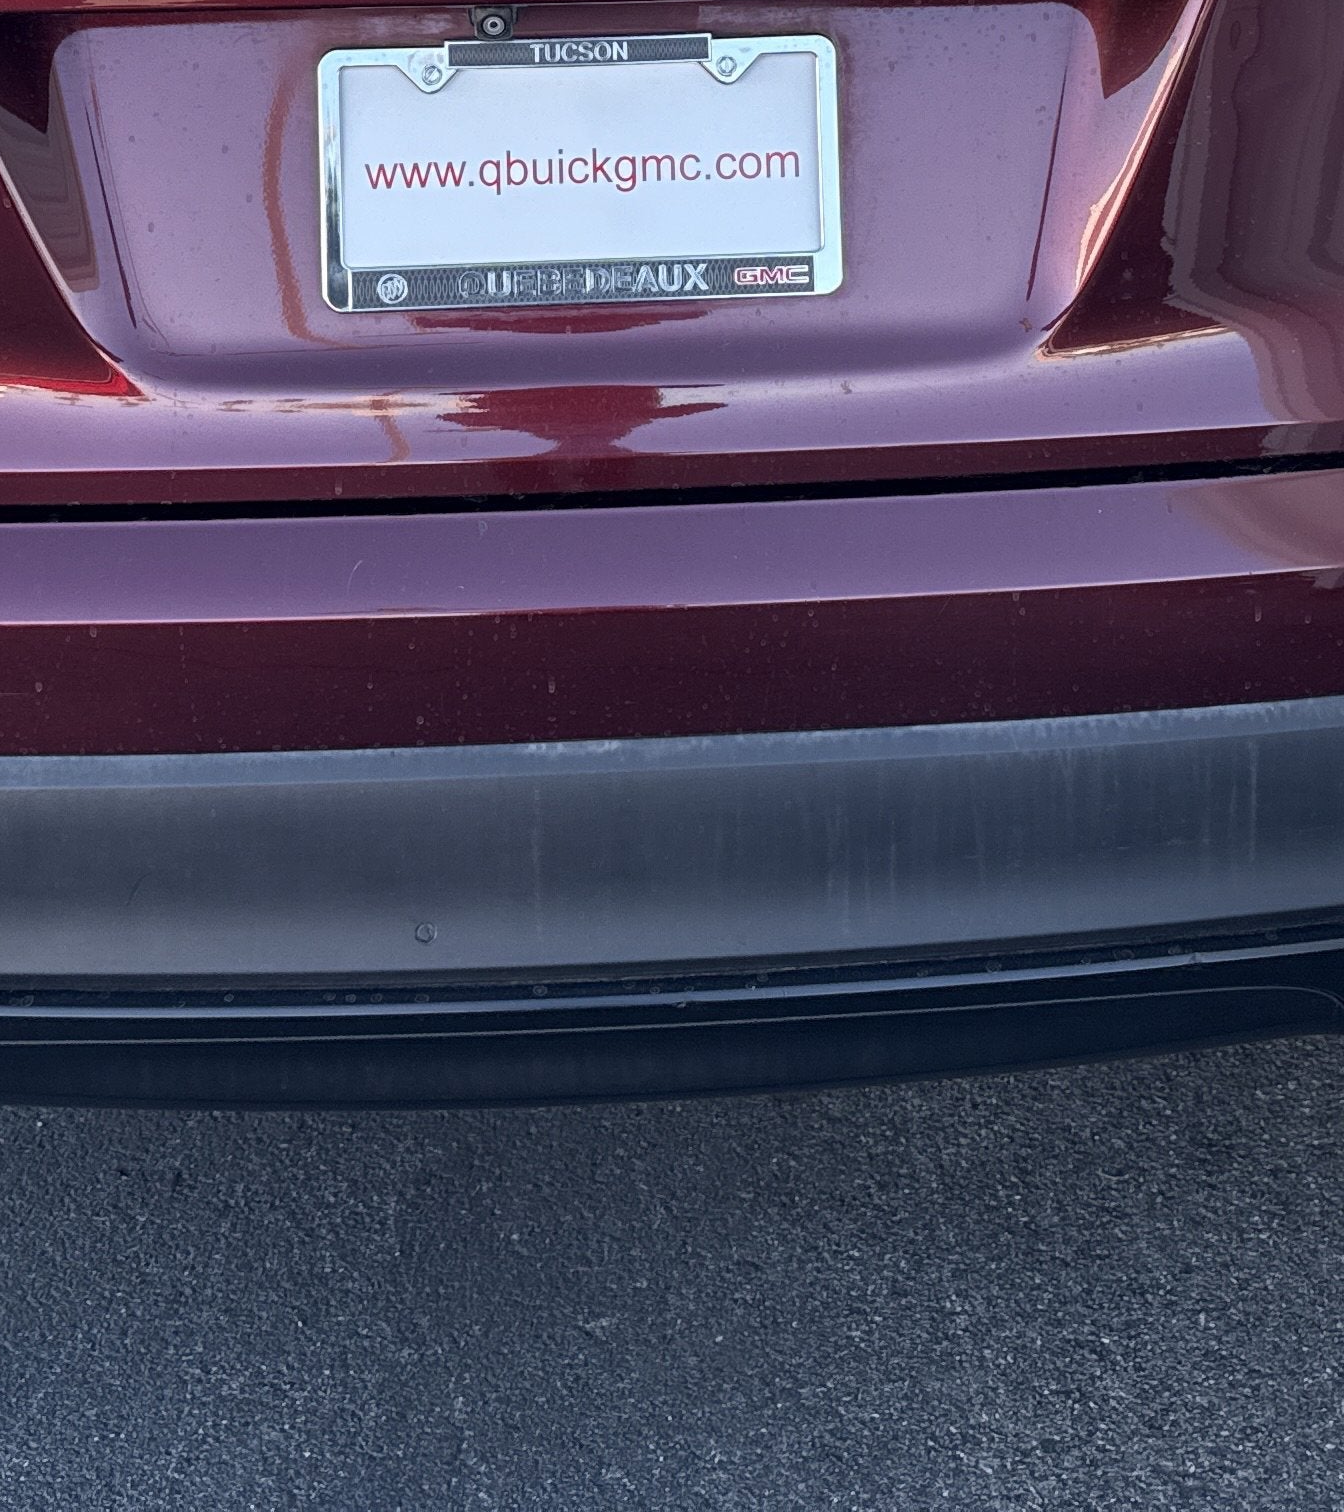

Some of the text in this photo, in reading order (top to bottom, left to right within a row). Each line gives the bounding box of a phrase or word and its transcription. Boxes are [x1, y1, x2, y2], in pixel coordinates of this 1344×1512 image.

[529, 40, 629, 64] TUCSON
[364, 147, 801, 195] www.qbuickgmc.com
[458, 262, 810, 299] QUEBEDEAUX GMC
